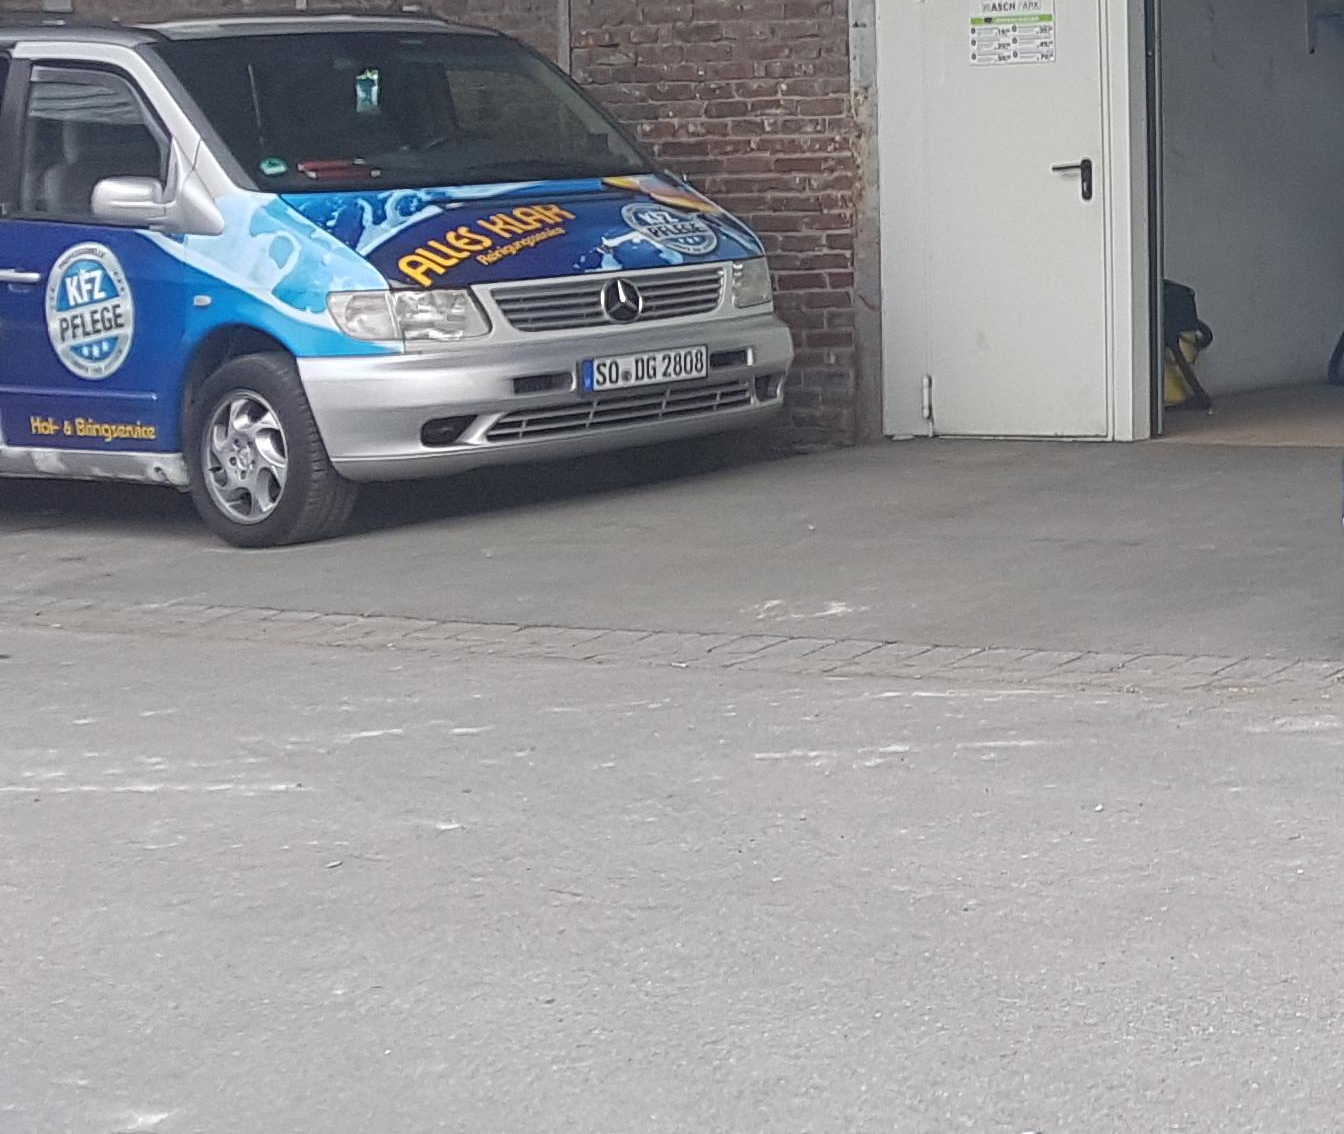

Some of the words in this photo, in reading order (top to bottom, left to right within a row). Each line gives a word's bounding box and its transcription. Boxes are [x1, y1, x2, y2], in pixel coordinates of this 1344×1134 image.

[398, 226, 493, 288] ALLES
[476, 204, 576, 238] KLAR
[65, 269, 107, 307] KFZ
[59, 304, 125, 343] PFLEGE
[596, 360, 619, 385] SO
[635, 356, 657, 381] DG
[662, 349, 704, 378] 2808
